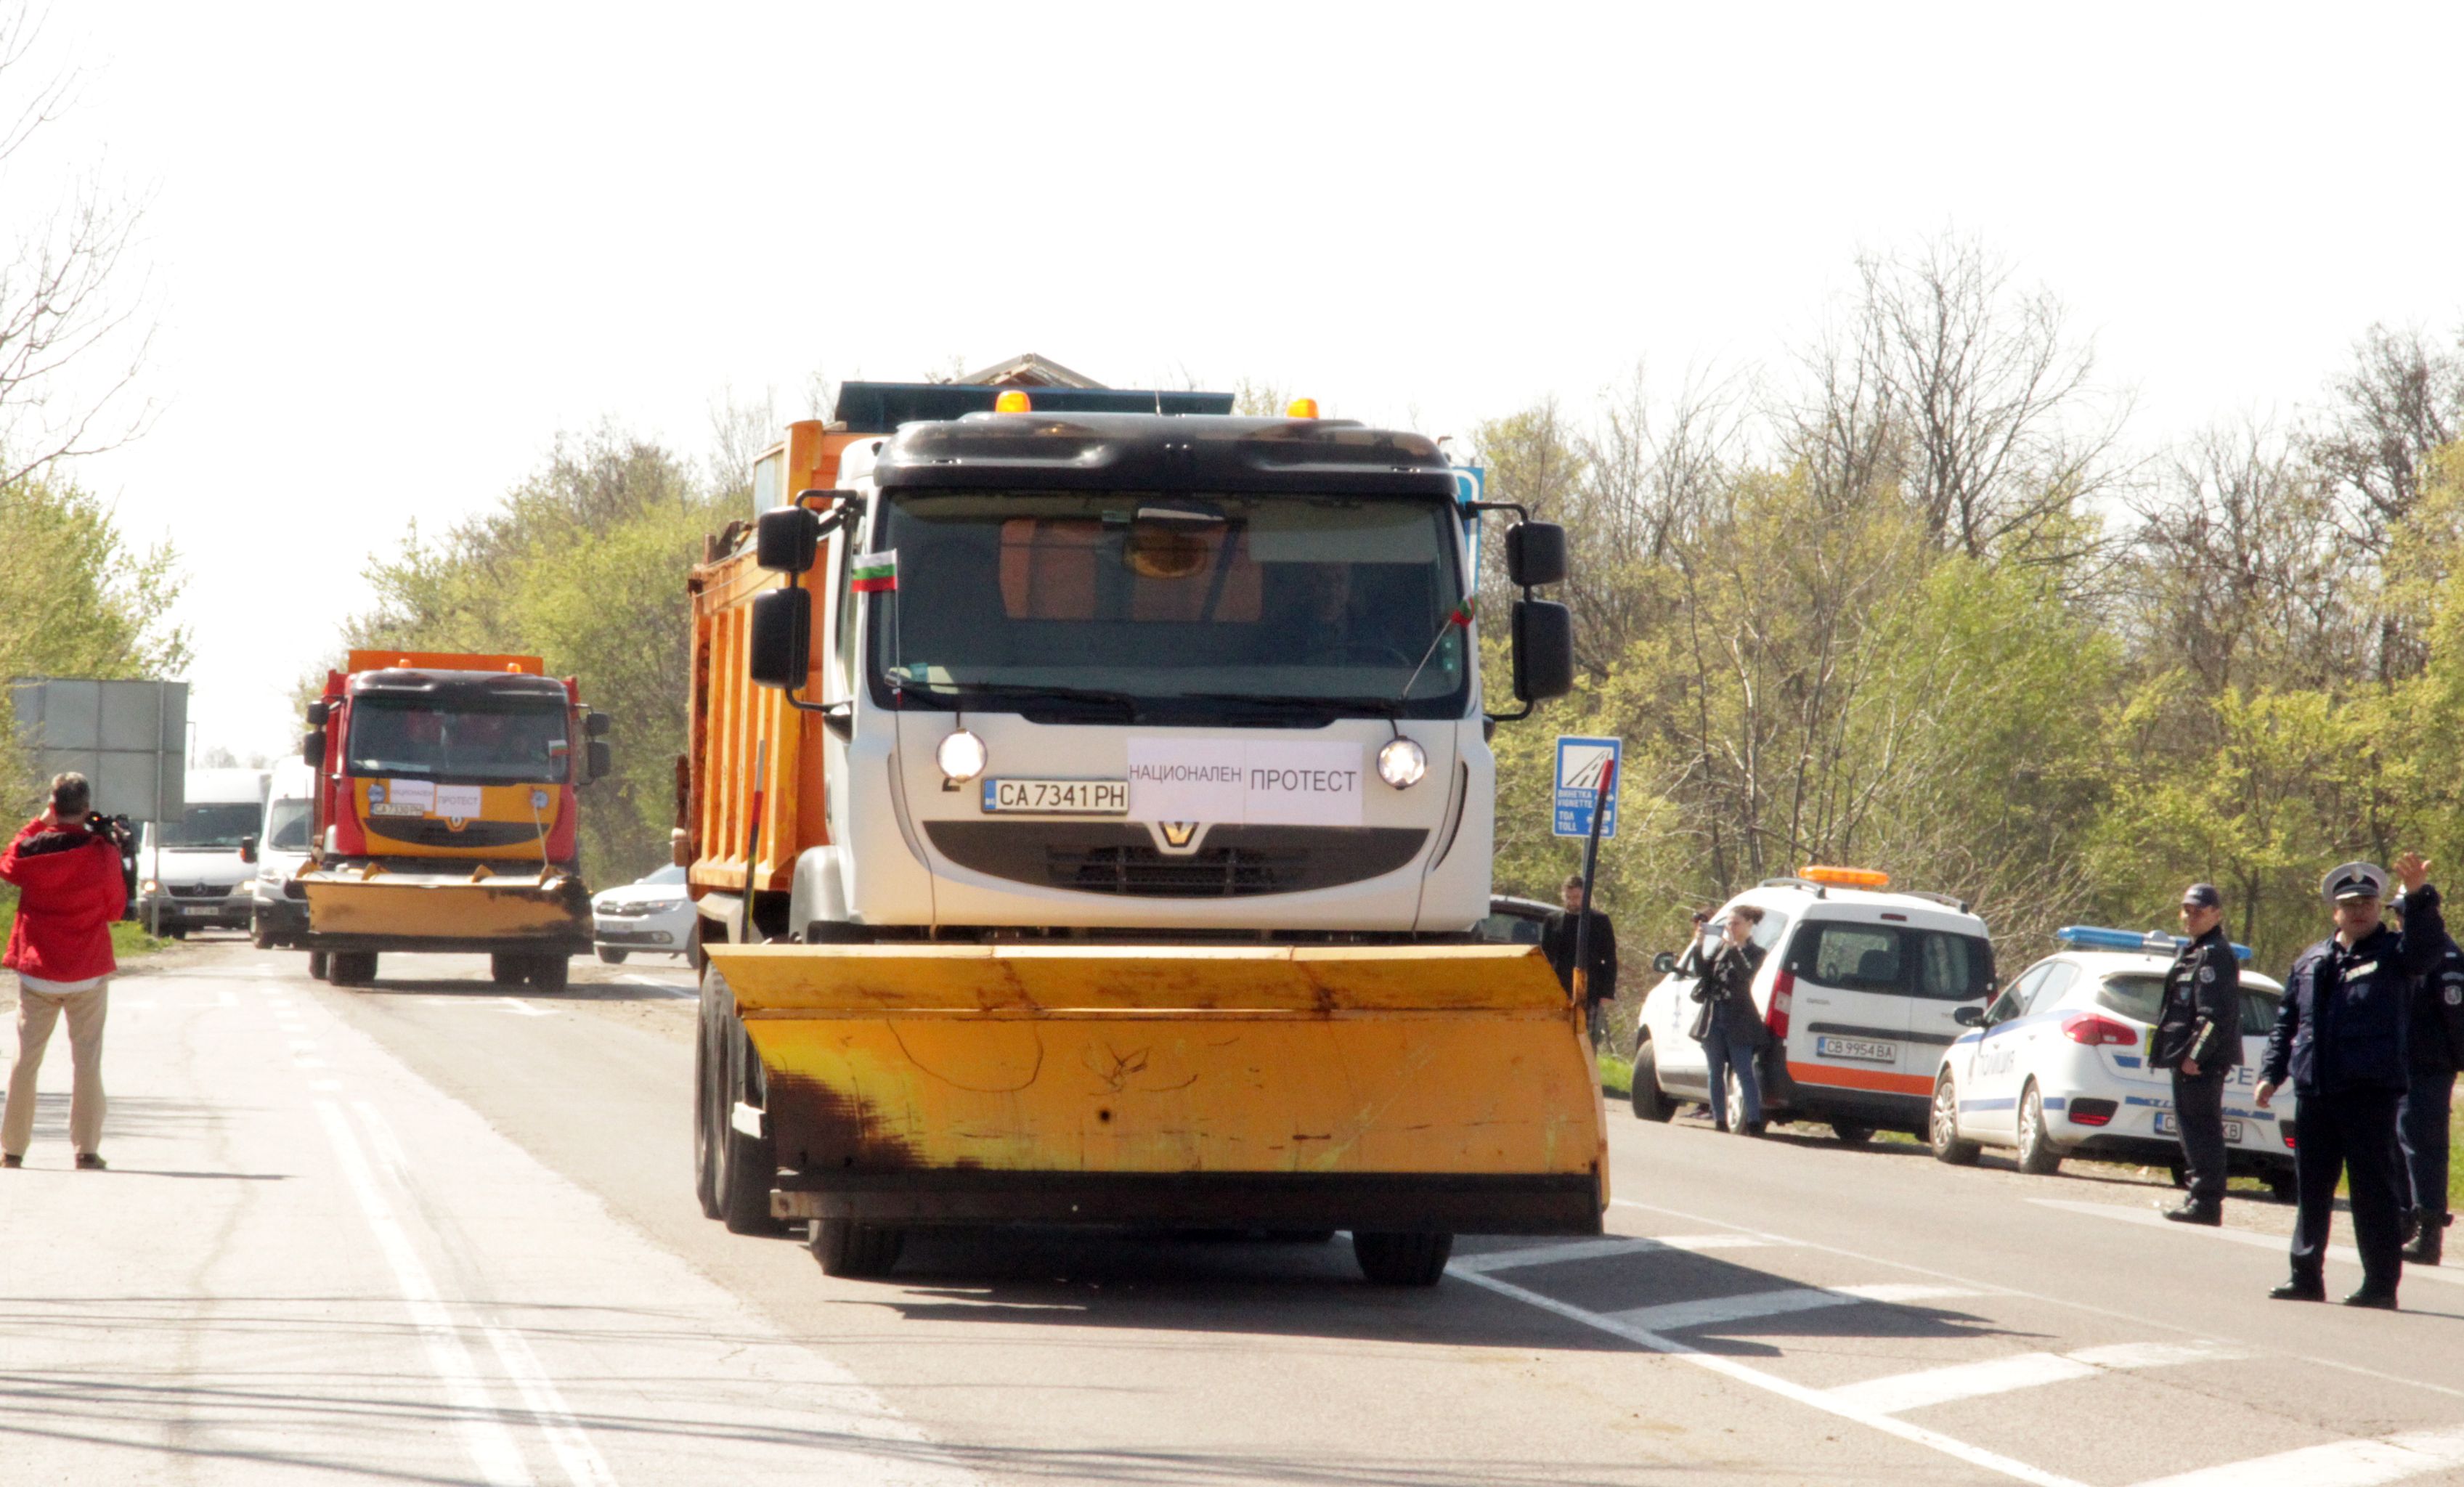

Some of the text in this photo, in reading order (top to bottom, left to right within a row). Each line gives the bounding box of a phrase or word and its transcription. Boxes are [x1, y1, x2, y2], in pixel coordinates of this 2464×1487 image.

[1129, 765, 1357, 791] НАЦИОНАЛЕН ПРОТЕСТ
[1034, 784, 1087, 807] 7341
